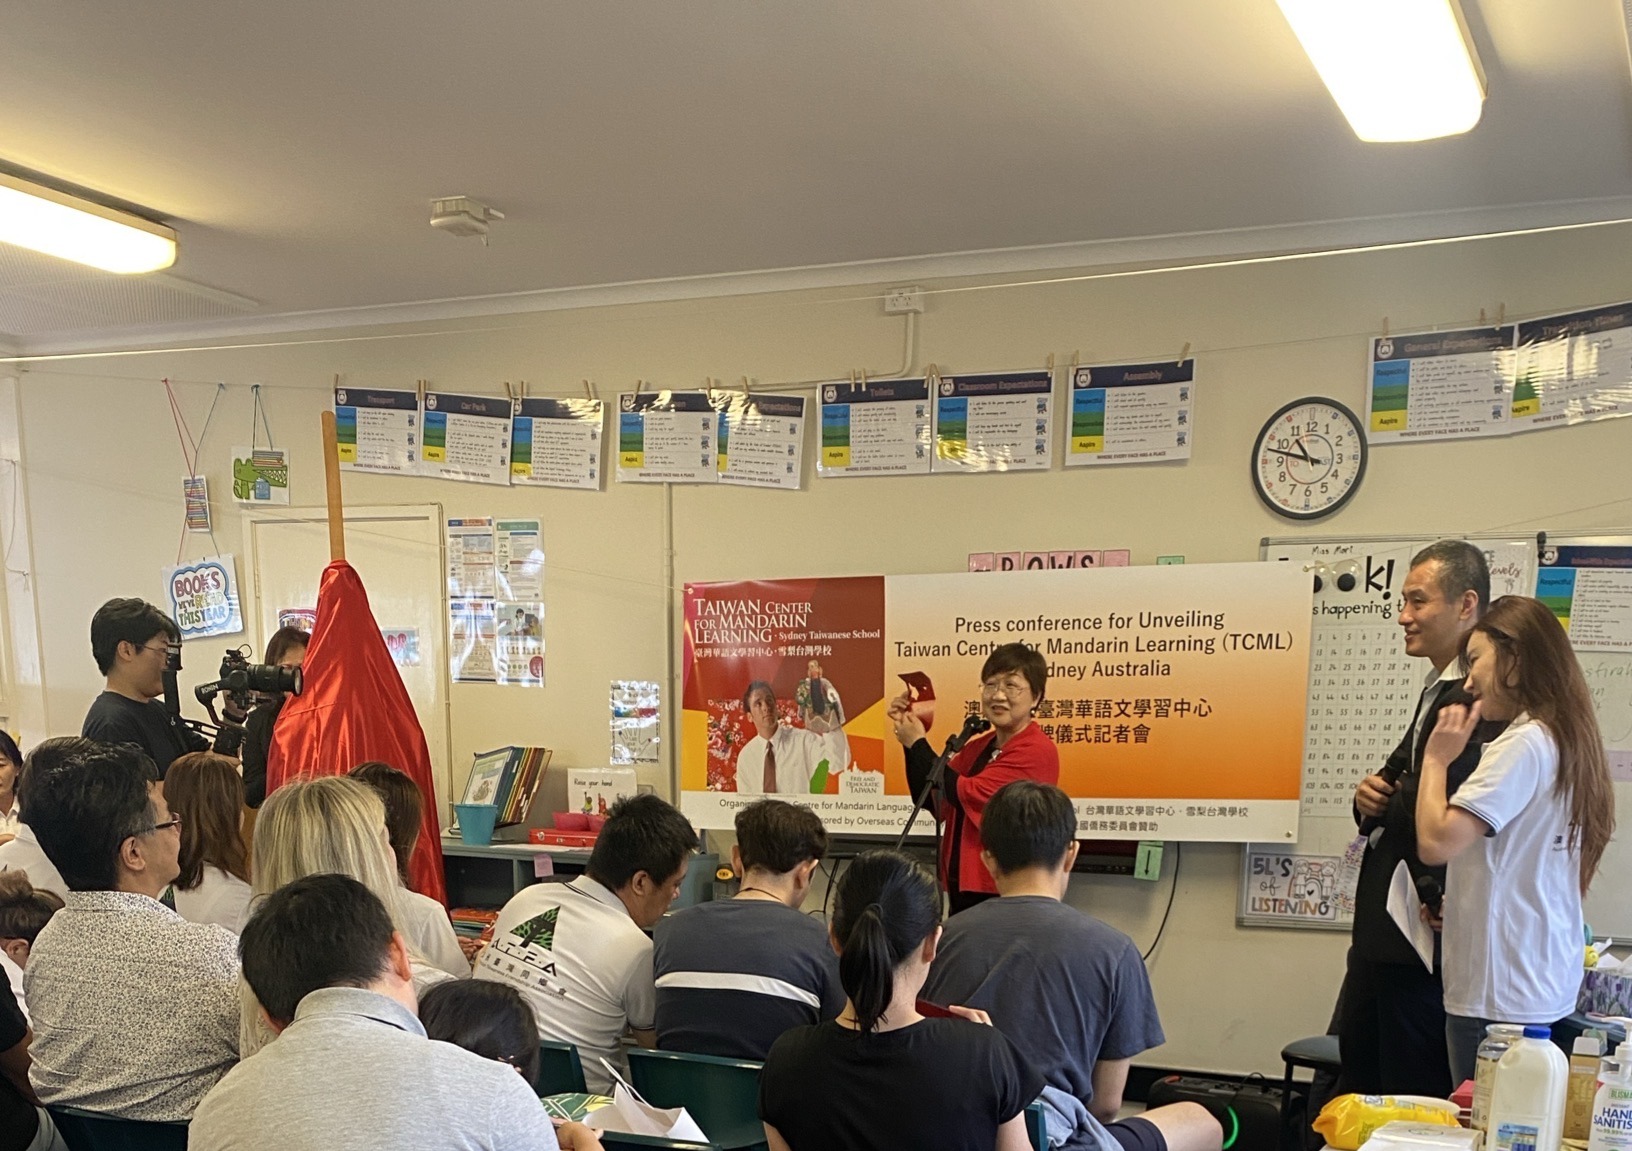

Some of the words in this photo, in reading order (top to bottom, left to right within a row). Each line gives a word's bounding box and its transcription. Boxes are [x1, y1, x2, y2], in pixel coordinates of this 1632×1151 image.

[1123, 370, 1163, 381] Assembly
[999, 380, 1048, 390] Expectations
[461, 402, 472, 410] Car
[473, 403, 486, 411] Park
[1379, 417, 1398, 425] Aspire
[1291, 425, 1301, 436] 11
[1306, 422, 1318, 433] 12
[1324, 424, 1330, 434] 1
[1276, 438, 1289, 449] 10
[1335, 435, 1343, 446] 2
[1276, 456, 1284, 467] 9
[1336, 453, 1343, 464] 3
[1279, 471, 1286, 482] 8
[1331, 469, 1339, 480] 4
[1289, 484, 1297, 495] 7
[1304, 486, 1312, 497] 6
[1320, 482, 1328, 493] 5
[693, 598, 761, 615] TAIWAN
[765, 602, 813, 614] CENTER
[1322, 600, 1392, 619] happening
[178, 610, 201, 626] THIS
[694, 619, 716, 630] FOR
[718, 613, 808, 629] MANDARIN
[955, 617, 1001, 633] Press
[1006, 615, 1102, 632] conference
[1108, 612, 1133, 629] for
[1139, 610, 1225, 630] Unveiling
[694, 629, 772, 644] LEARNING
[778, 631, 808, 642] Sydney
[809, 630, 851, 640] Taiwanese
[852, 629, 881, 639] School
[894, 641, 951, 657] Taiwan
[1047, 636, 1128, 654] Mandarin
[1136, 635, 1216, 655] Learning
[1222, 631, 1293, 653] (TCML)
[1046, 662, 1086, 680] dney
[1092, 659, 1171, 677] Australia
[850, 786, 877, 794] TAIWAN
[821, 802, 833, 810] for
[835, 802, 875, 811] Mandarin
[876, 803, 916, 813] Languag
[845, 816, 854, 826] by
[857, 817, 895, 826] Overseas
[1253, 858, 1293, 877] 5L'S
[1260, 877, 1281, 896] of
[1251, 896, 1330, 916] LISTENING
[1593, 1115, 1632, 1130] SANITIS
